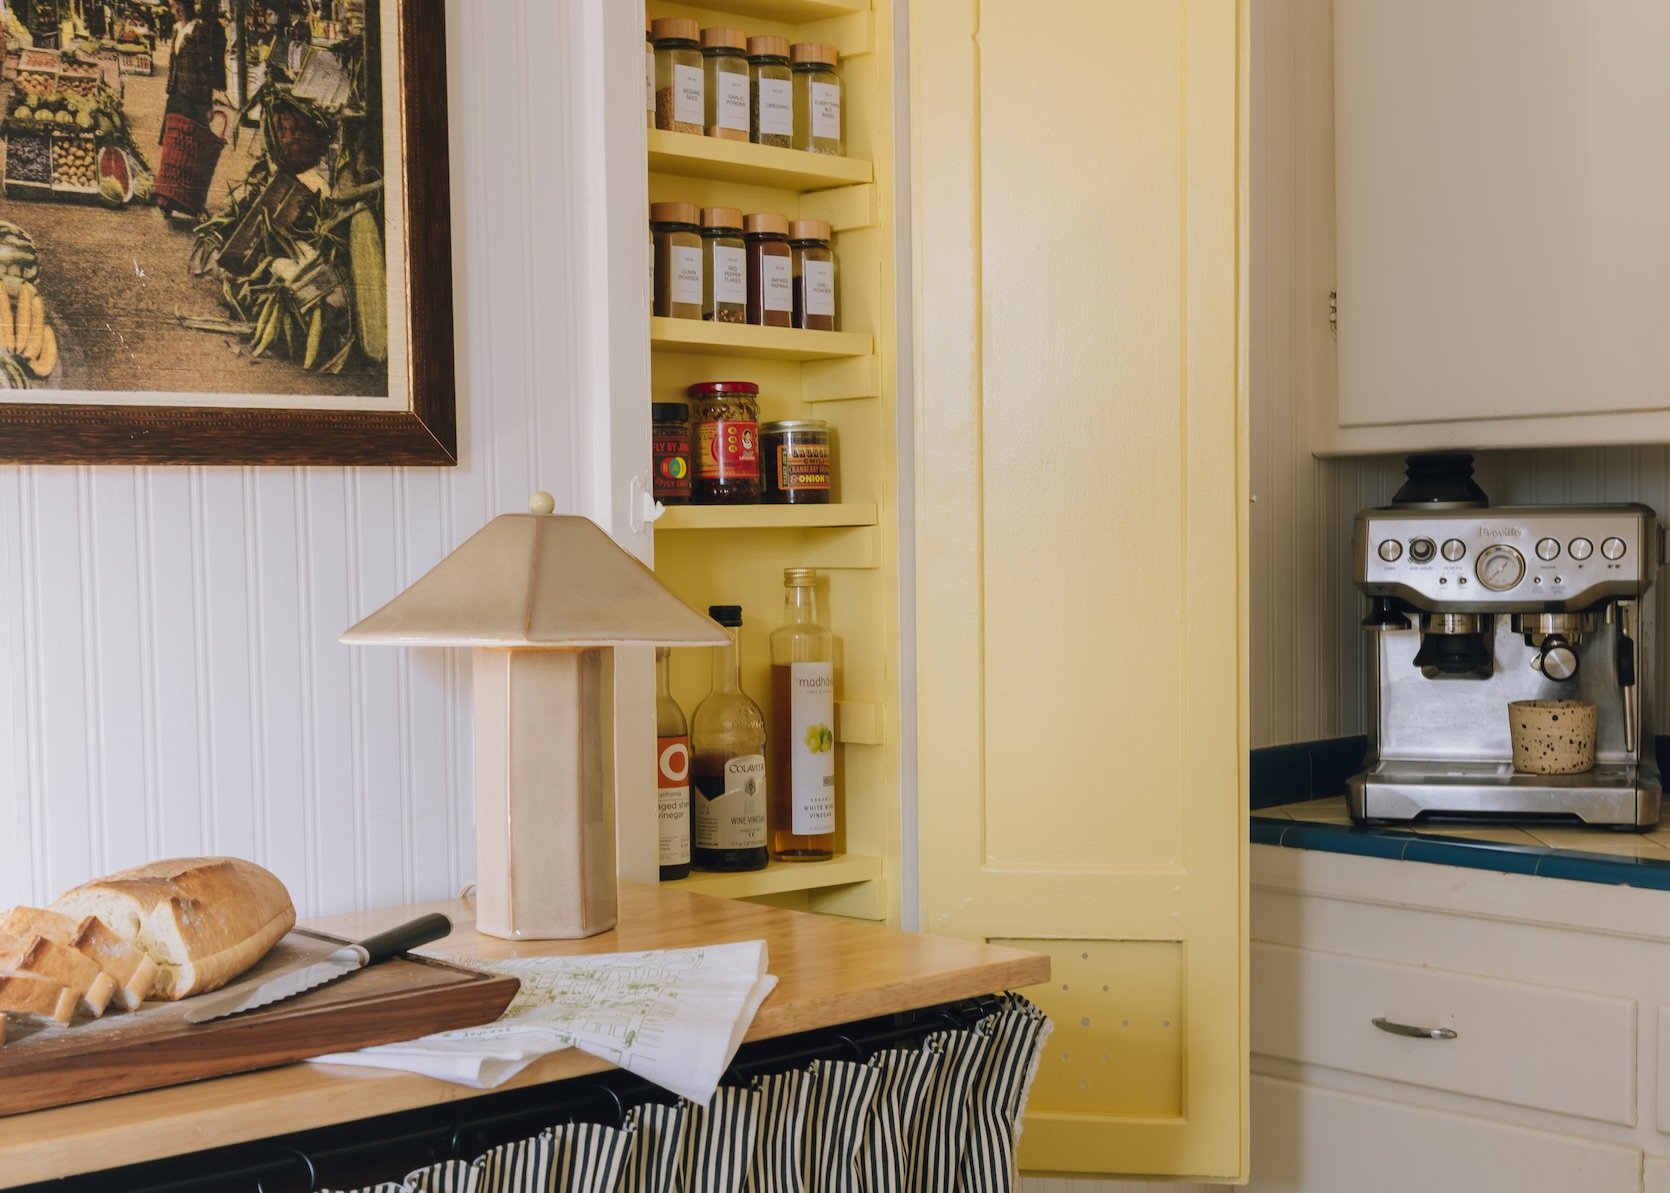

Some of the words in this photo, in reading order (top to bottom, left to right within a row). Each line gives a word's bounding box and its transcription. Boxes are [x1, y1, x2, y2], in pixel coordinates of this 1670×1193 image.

[667, 442, 677, 452] BY
[656, 478, 675, 487] SPICY
[799, 475, 825, 483] ONION
[729, 763, 764, 774] COLAVITA
[730, 817, 746, 825] WINE
